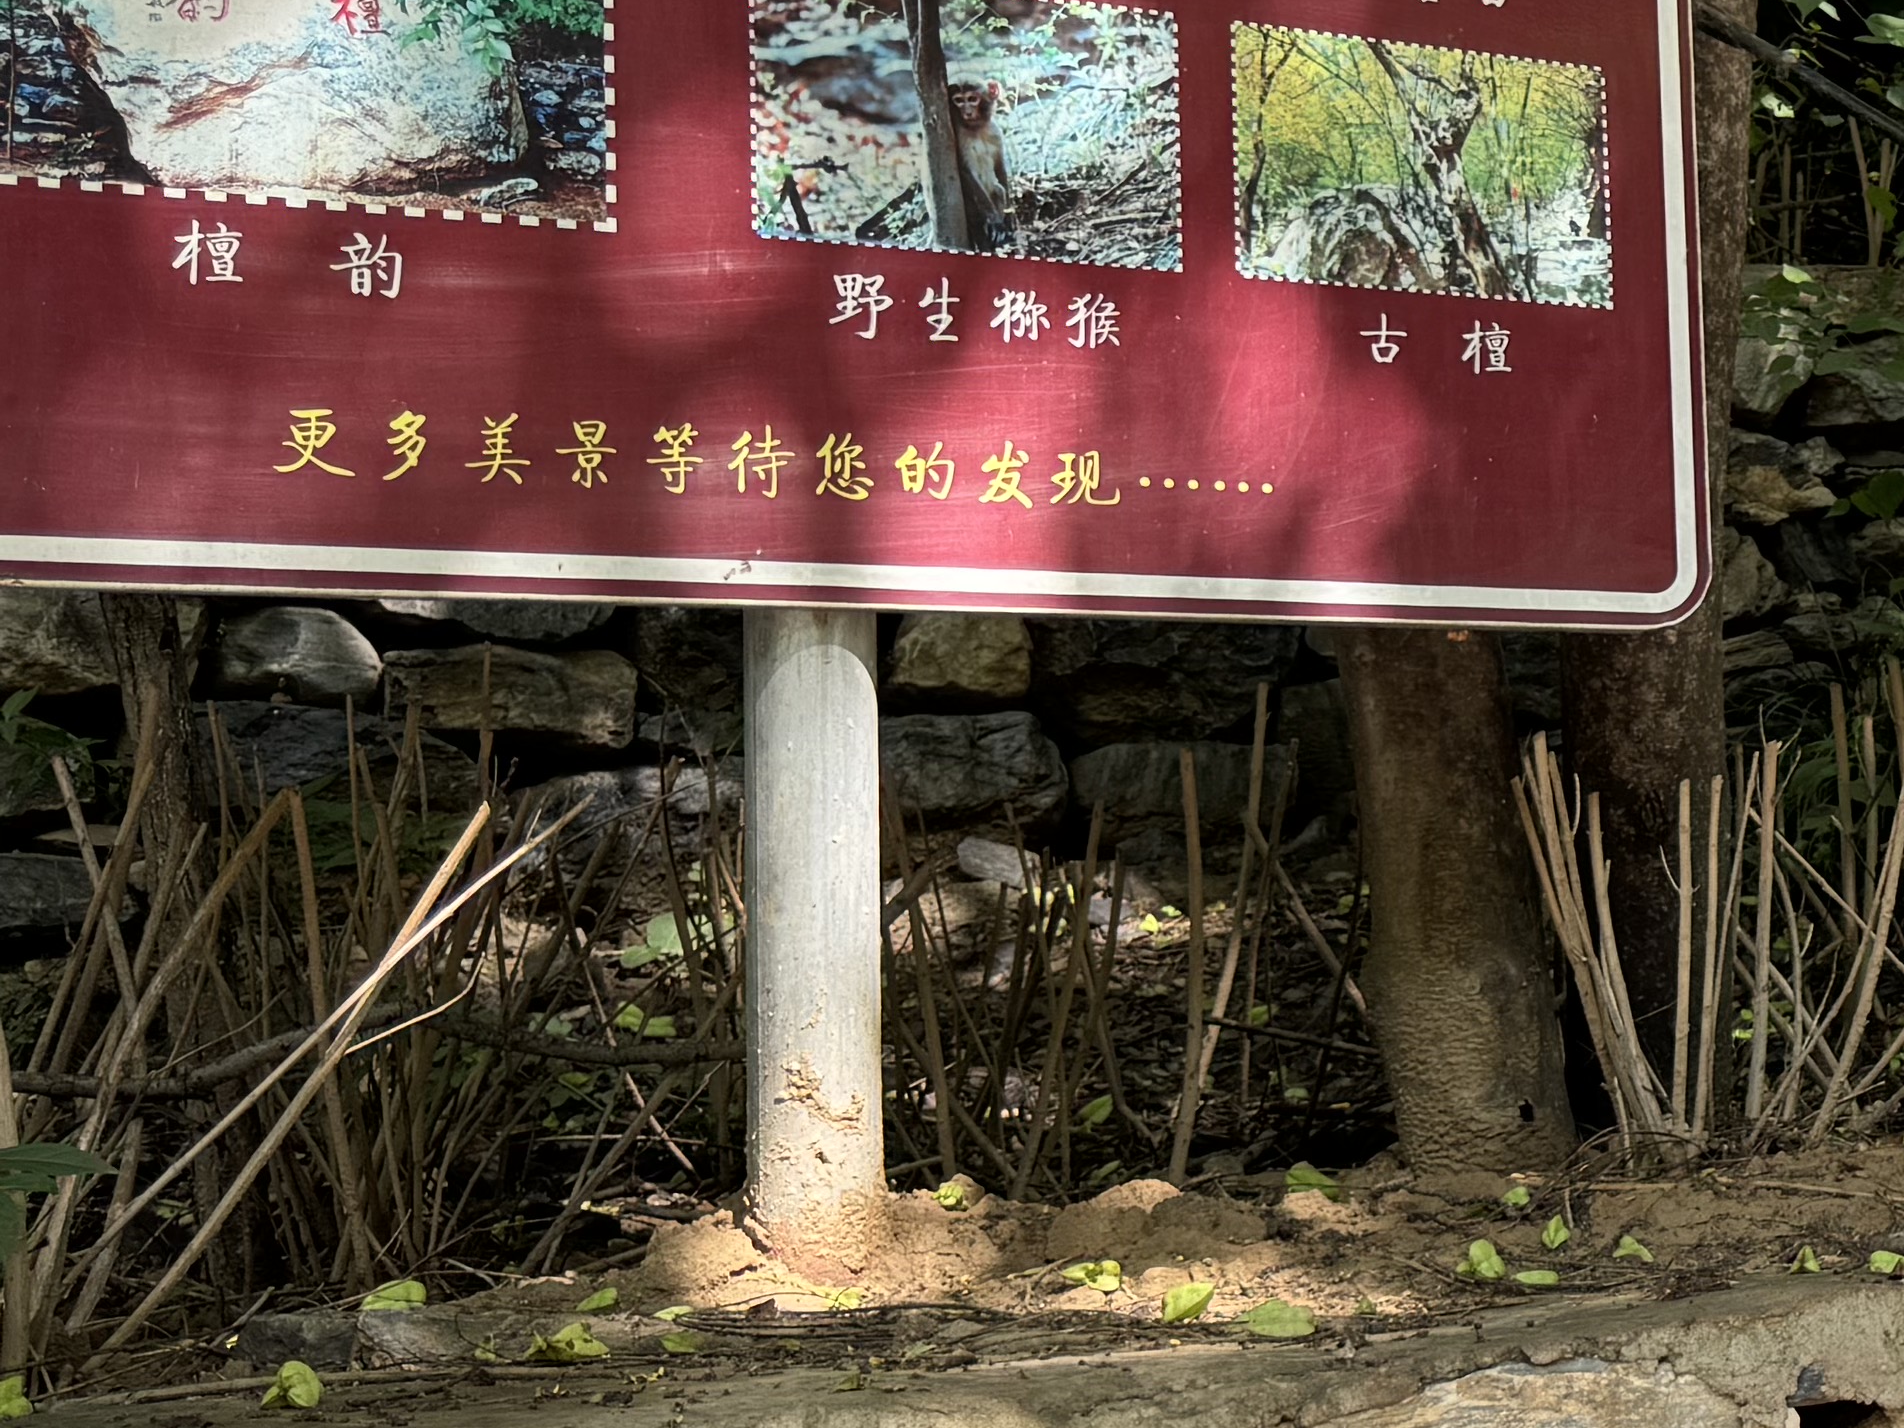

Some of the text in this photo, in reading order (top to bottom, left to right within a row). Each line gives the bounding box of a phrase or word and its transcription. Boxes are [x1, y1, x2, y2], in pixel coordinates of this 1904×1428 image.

[171, 219, 403, 299] 檀韵
[828, 273, 1121, 349] 野生猕猴
[1359, 312, 1513, 375] 古檀
